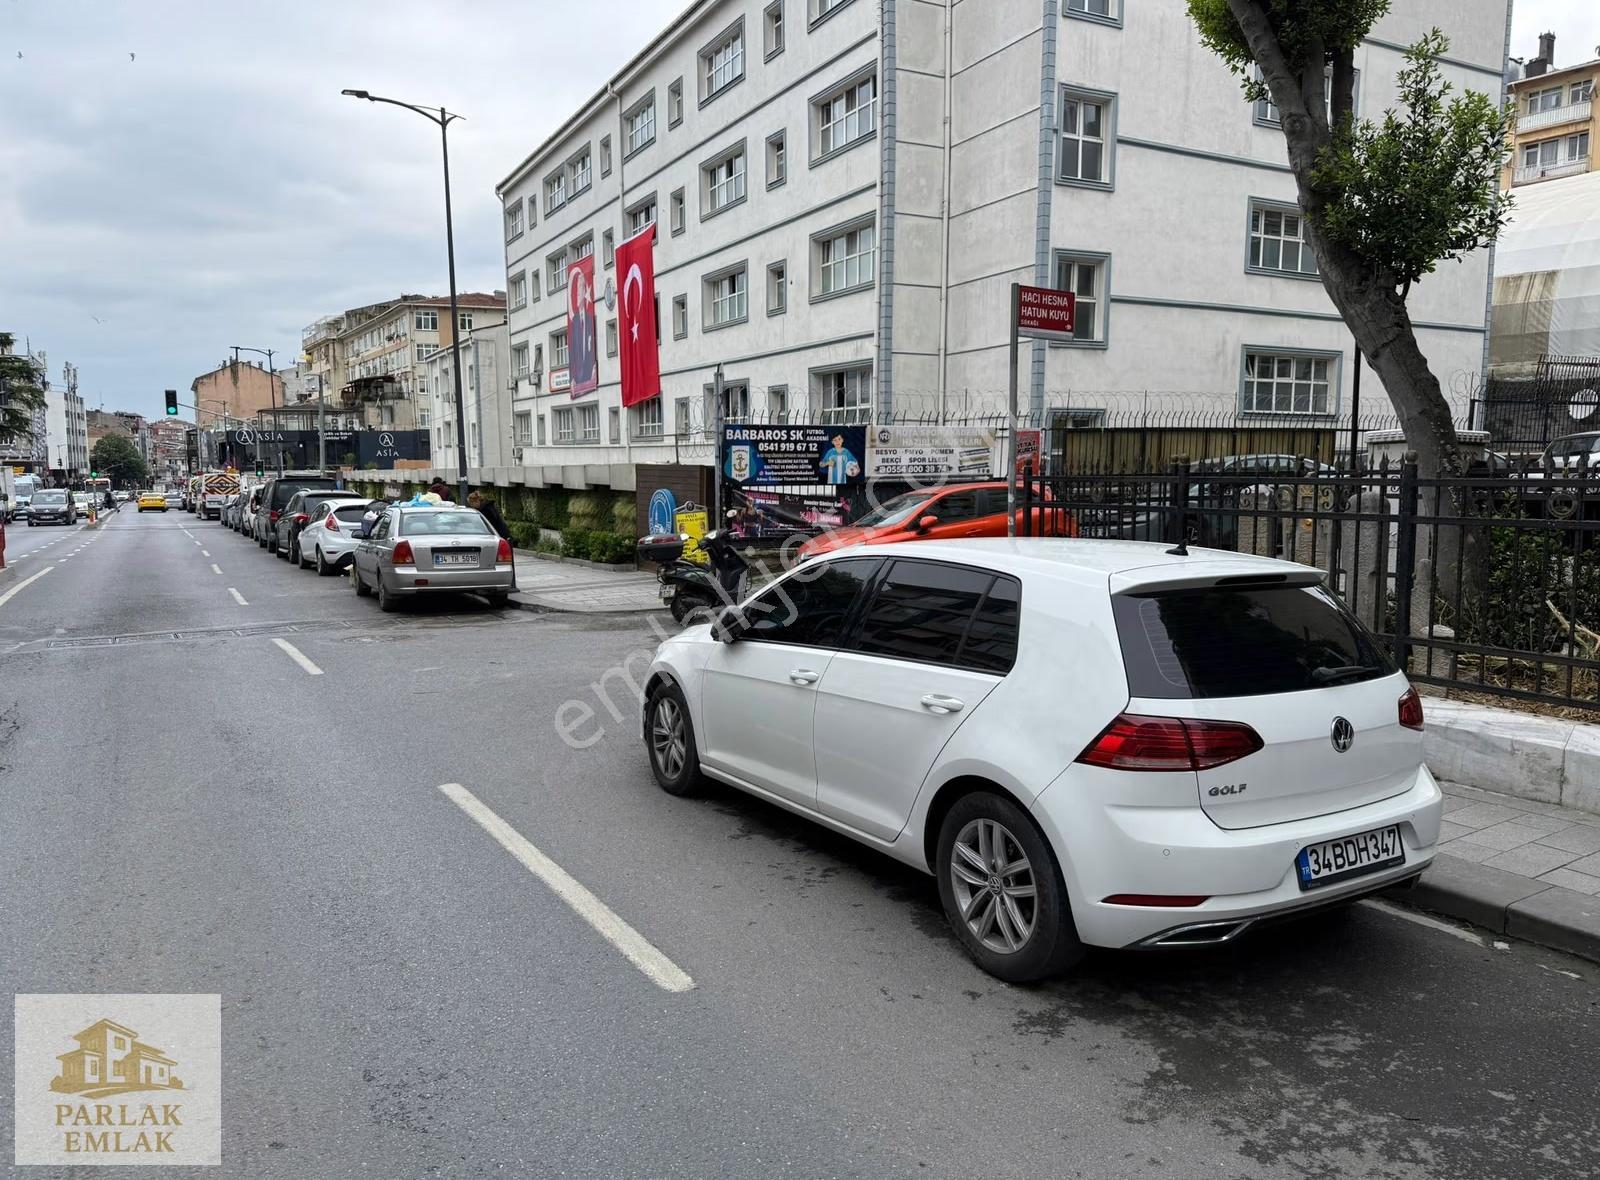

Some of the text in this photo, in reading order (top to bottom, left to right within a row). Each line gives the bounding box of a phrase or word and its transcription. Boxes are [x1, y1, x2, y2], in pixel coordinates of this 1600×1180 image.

[1021, 291, 1069, 307] HACI HESNA
[1021, 306, 1069, 321] HATUN KUYU
[726, 429, 804, 440] BARBAROS SK
[758, 443, 818, 451] 0541 919 67 12
[881, 456, 901, 464] BEKÇİ
[886, 465, 906, 473] 0554
[1208, 783, 1247, 797] GOLF
[1302, 867, 1311, 875] TR
